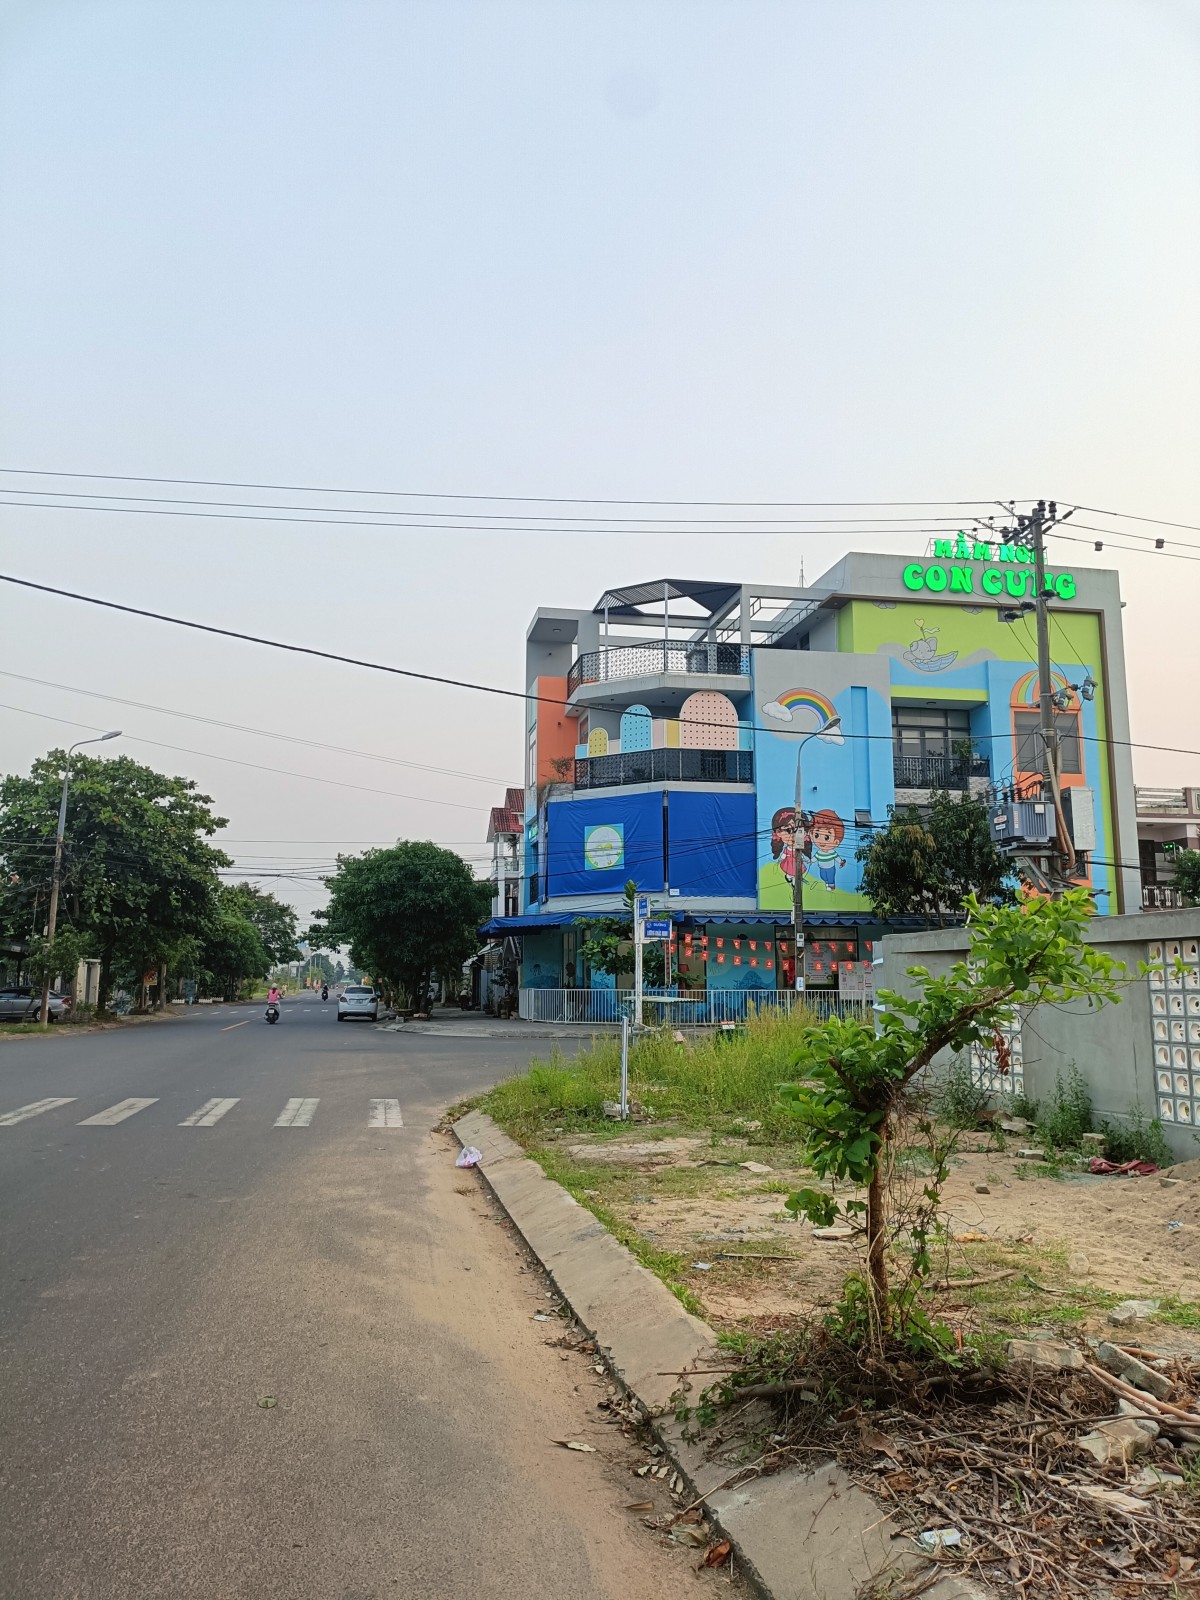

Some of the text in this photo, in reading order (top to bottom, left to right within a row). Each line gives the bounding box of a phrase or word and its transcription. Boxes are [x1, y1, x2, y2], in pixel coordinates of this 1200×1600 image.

[934, 531, 992, 560] MẦM
[903, 563, 1076, 600] CON CƯNG
